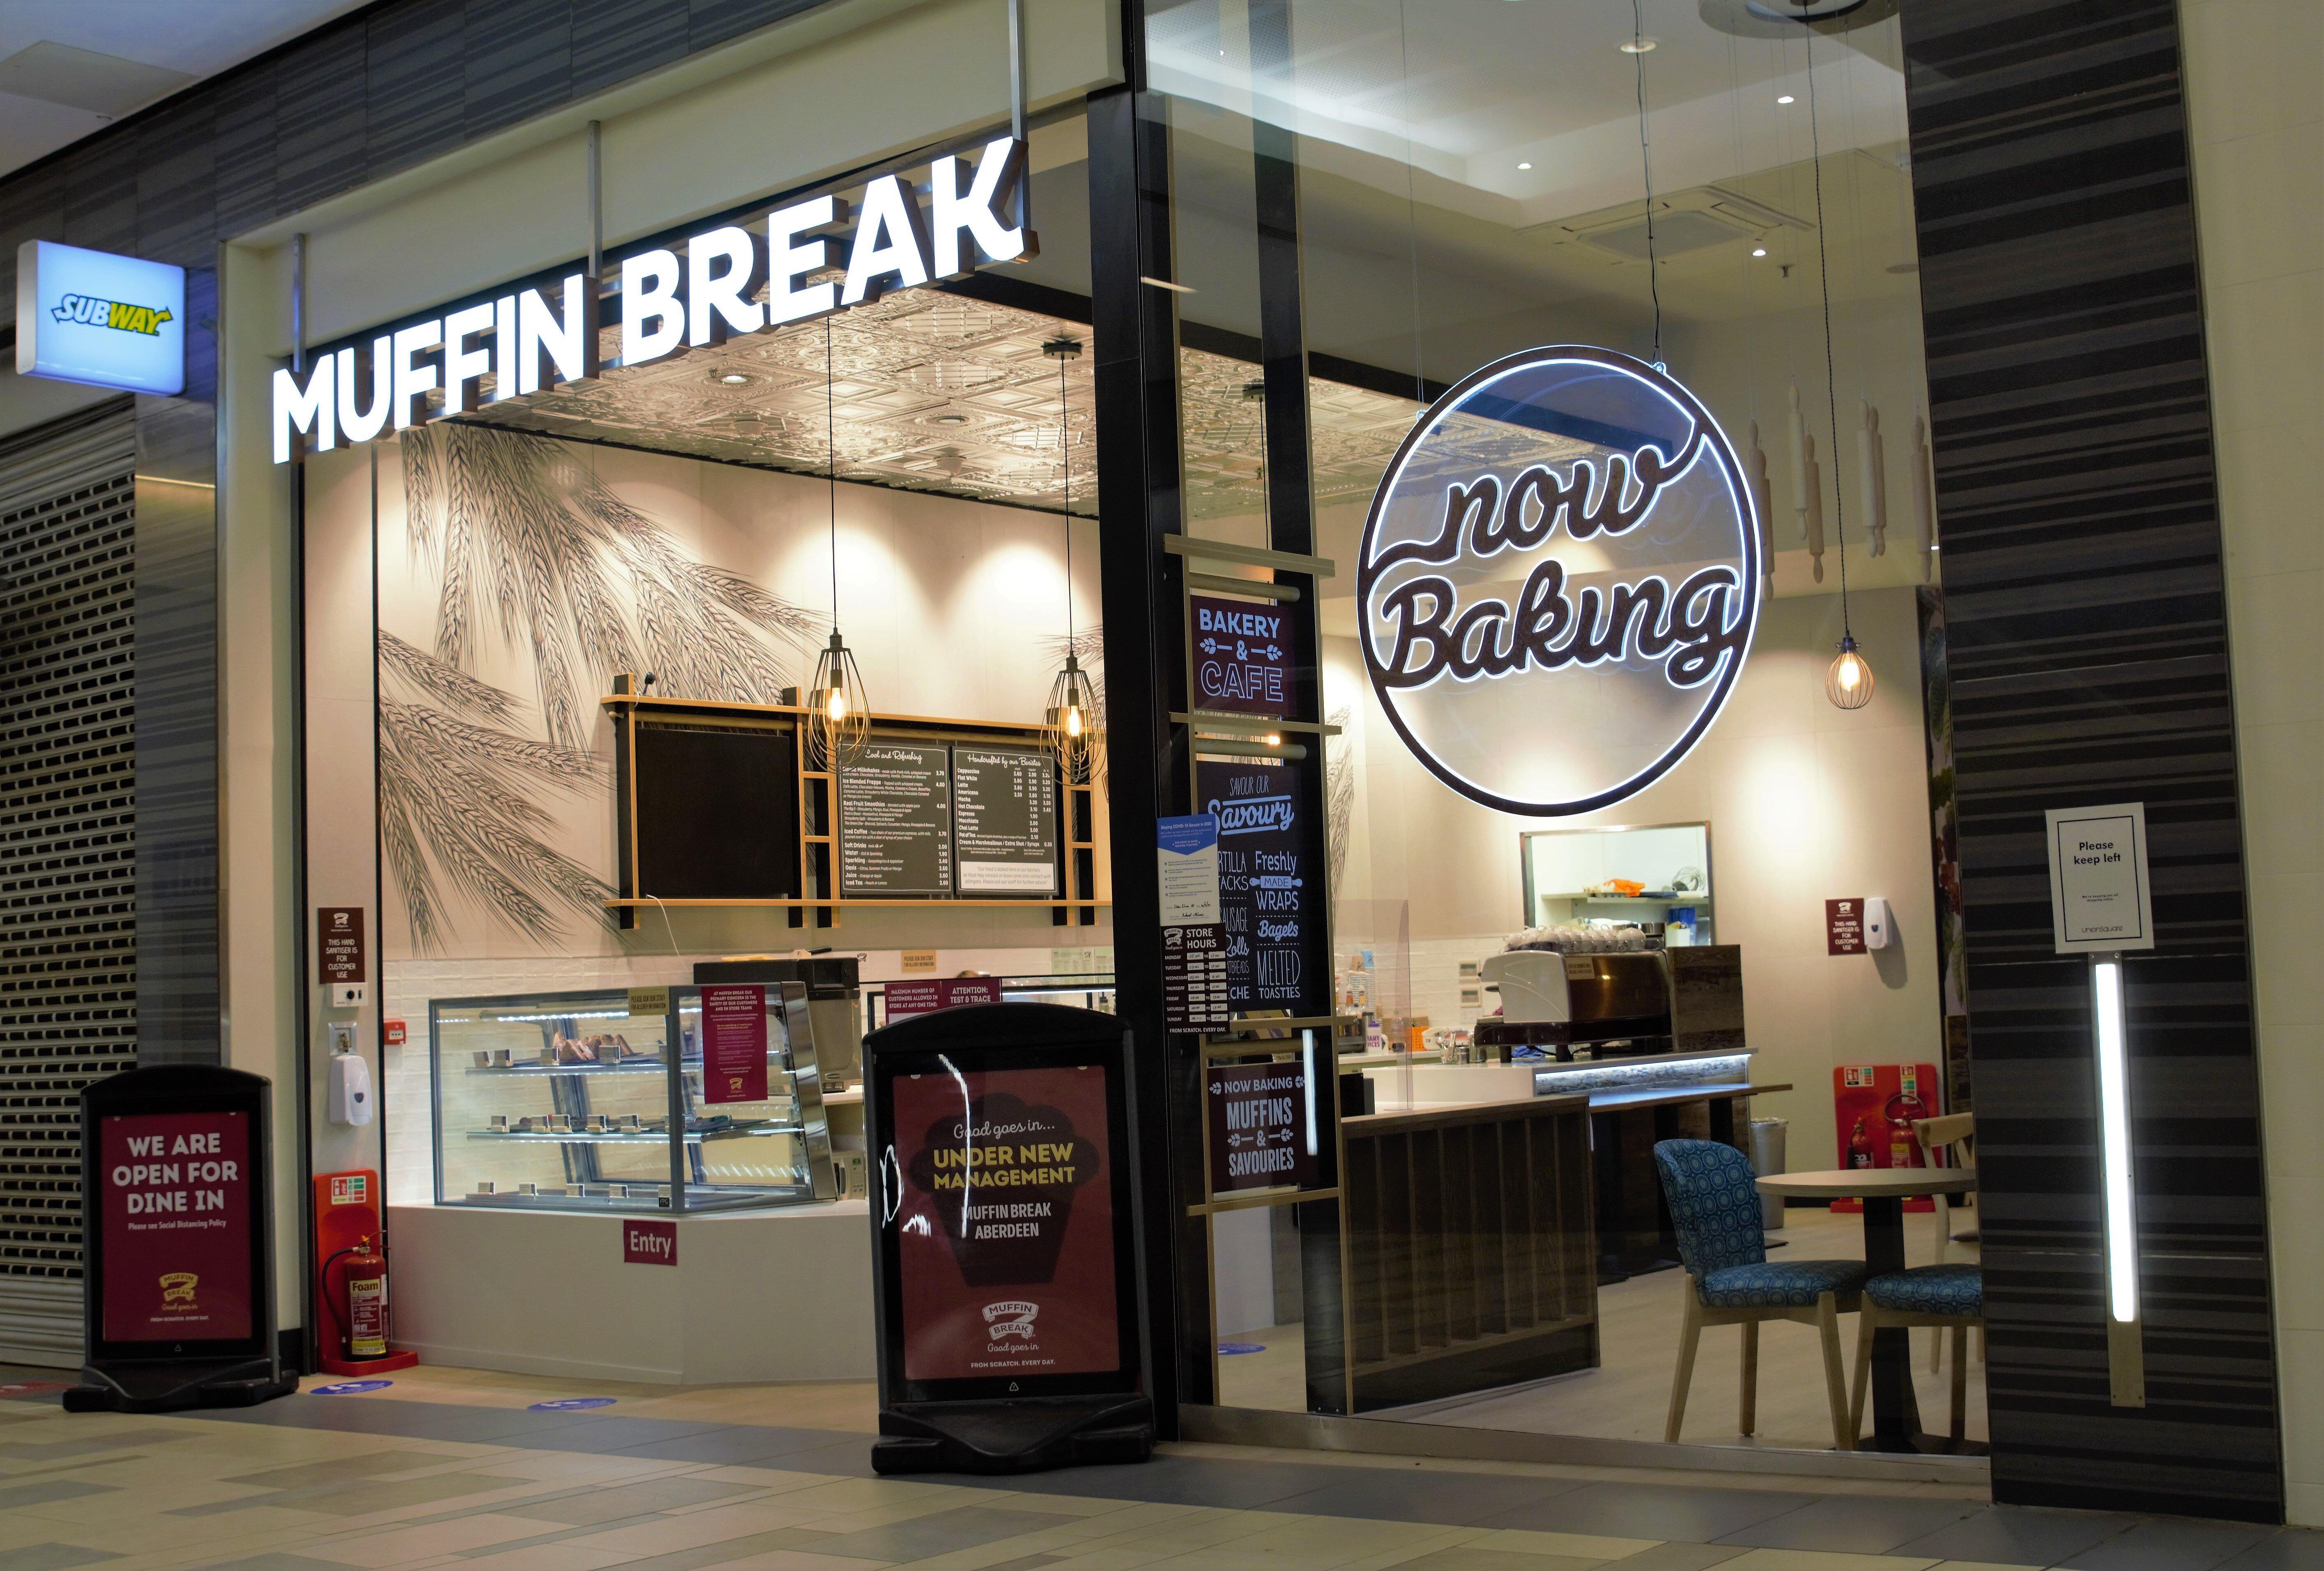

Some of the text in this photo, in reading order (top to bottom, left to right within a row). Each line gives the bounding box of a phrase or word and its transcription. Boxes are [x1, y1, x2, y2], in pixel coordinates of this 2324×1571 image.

[273, 137, 1024, 464] MUFFIN BREAK
[51, 293, 173, 336] SUBWAY
[1423, 443, 1684, 561] now
[1199, 608, 1280, 638] BAKERY
[1382, 557, 1741, 691] Baking
[1236, 640, 1248, 660] &
[1201, 661, 1283, 702] CAFE
[892, 751, 922, 764] Refreshing
[967, 753, 1001, 765] Handcrafted
[1002, 756, 1008, 768] by
[1019, 757, 1041, 766] Baristas
[1230, 775, 1269, 796] SAVOUR OUR
[1208, 799, 1294, 835] Savoury
[2079, 841, 2113, 850] Please
[1218, 851, 1247, 873] RTILLA
[1256, 850, 1296, 875] Freshly
[2074, 853, 2120, 865] keep left
[1264, 878, 1289, 887] MADE
[1256, 891, 1298, 910] WRAPS
[1186, 928, 1213, 938] STORE
[1258, 920, 1298, 942] Bagels
[1187, 939, 1216, 949] HOURS
[1257, 950, 1300, 985] MELTED
[952, 986, 988, 995] ATTENTION:
[1259, 986, 1300, 999] TOASTIES
[1224, 1077, 1293, 1093] NOW BAKING
[1226, 1097, 1293, 1130] MUFFINS
[993, 1123, 1026, 1139] goes
[1027, 1120, 1055, 1131] in...
[1256, 1130, 1266, 1146] &
[127, 1133, 221, 1157] WE ARE
[934, 1143, 1073, 1168] UNDER NEW
[1229, 1147, 1294, 1177] SAVOURIES
[113, 1160, 238, 1186] OPEN FOR
[934, 1167, 1075, 1189] MANAGEMENT
[127, 1189, 224, 1214] DINE IN
[962, 1202, 1052, 1220] MUFFIN BREAK
[177, 1220, 207, 1229] Distancing
[209, 1219, 227, 1228] Policy
[975, 1222, 1039, 1239] ABERDEEN
[630, 1231, 671, 1258] Entry
[352, 1282, 378, 1291] Foam
[989, 1304, 1032, 1314] MUFFIN
[994, 1325, 1028, 1334] BREAK
[987, 1343, 1009, 1352] Good
[1010, 1345, 1029, 1354] goes
